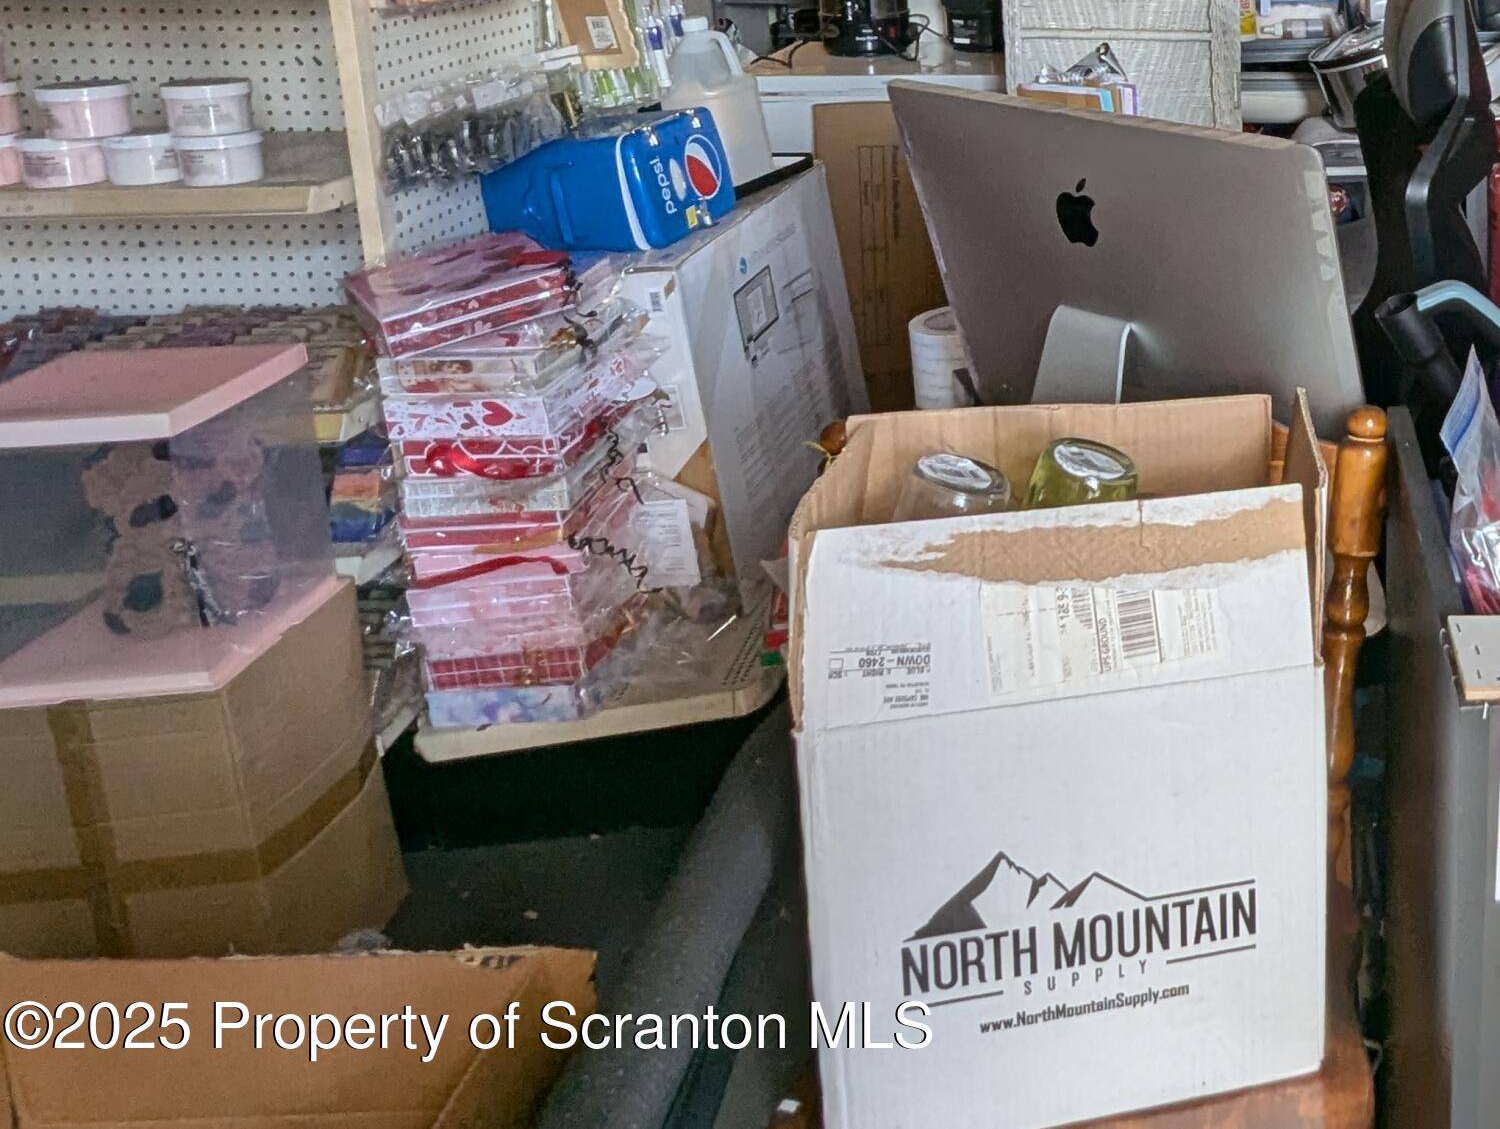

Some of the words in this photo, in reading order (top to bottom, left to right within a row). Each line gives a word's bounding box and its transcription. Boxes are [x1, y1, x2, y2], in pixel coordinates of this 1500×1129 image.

[649, 155, 678, 215] pepsi
[1098, 617, 1111, 655] GROUND
[858, 656, 885, 669] 2460
[896, 654, 931, 667] DOWN
[1102, 655, 1112, 672] UPS
[901, 925, 1038, 997] NORTH
[1053, 887, 1257, 971] MOUNTAIN
[1023, 959, 1148, 995] SUPPLY
[979, 982, 1190, 1034] www.NorthMountainSupply.com
